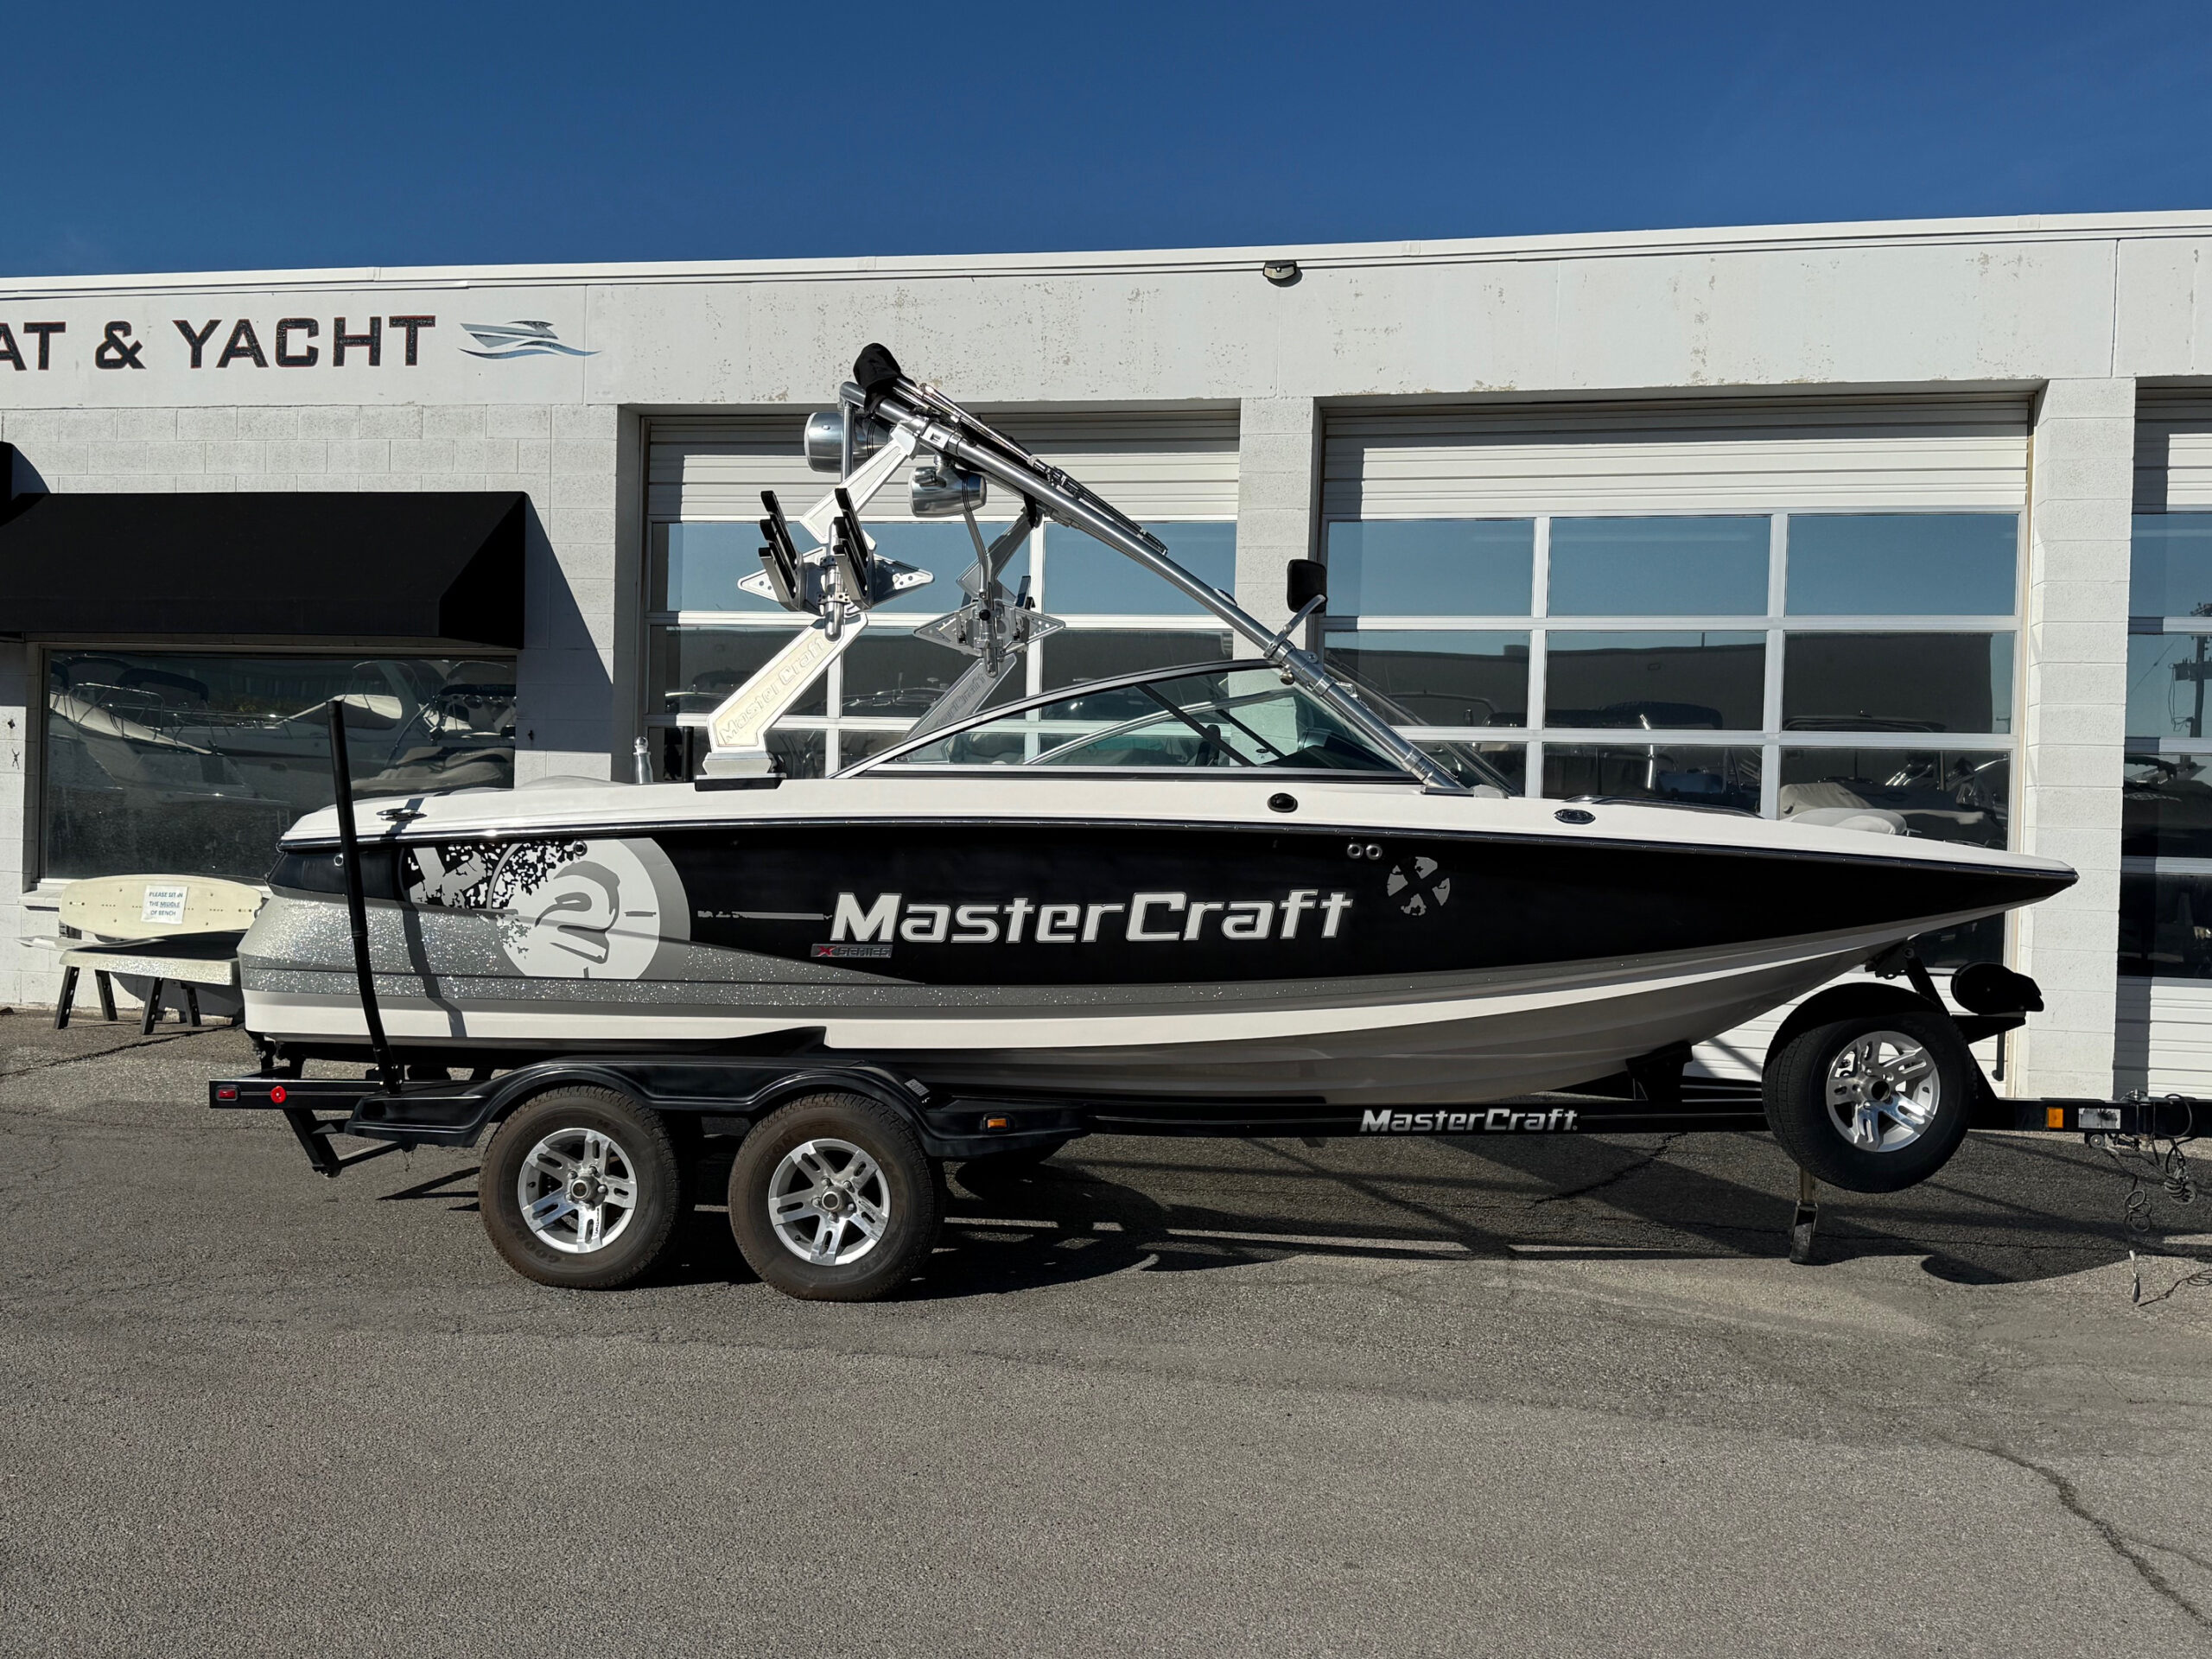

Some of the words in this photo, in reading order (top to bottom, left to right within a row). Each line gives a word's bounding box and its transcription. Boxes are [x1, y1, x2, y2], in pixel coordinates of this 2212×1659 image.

[95, 320, 147, 370] &
[172, 315, 435, 369] YACHT
[830, 889, 1353, 944] MasterCraft
[837, 947, 891, 958] SERIES
[1359, 1109, 1578, 1132] MasterCraft
